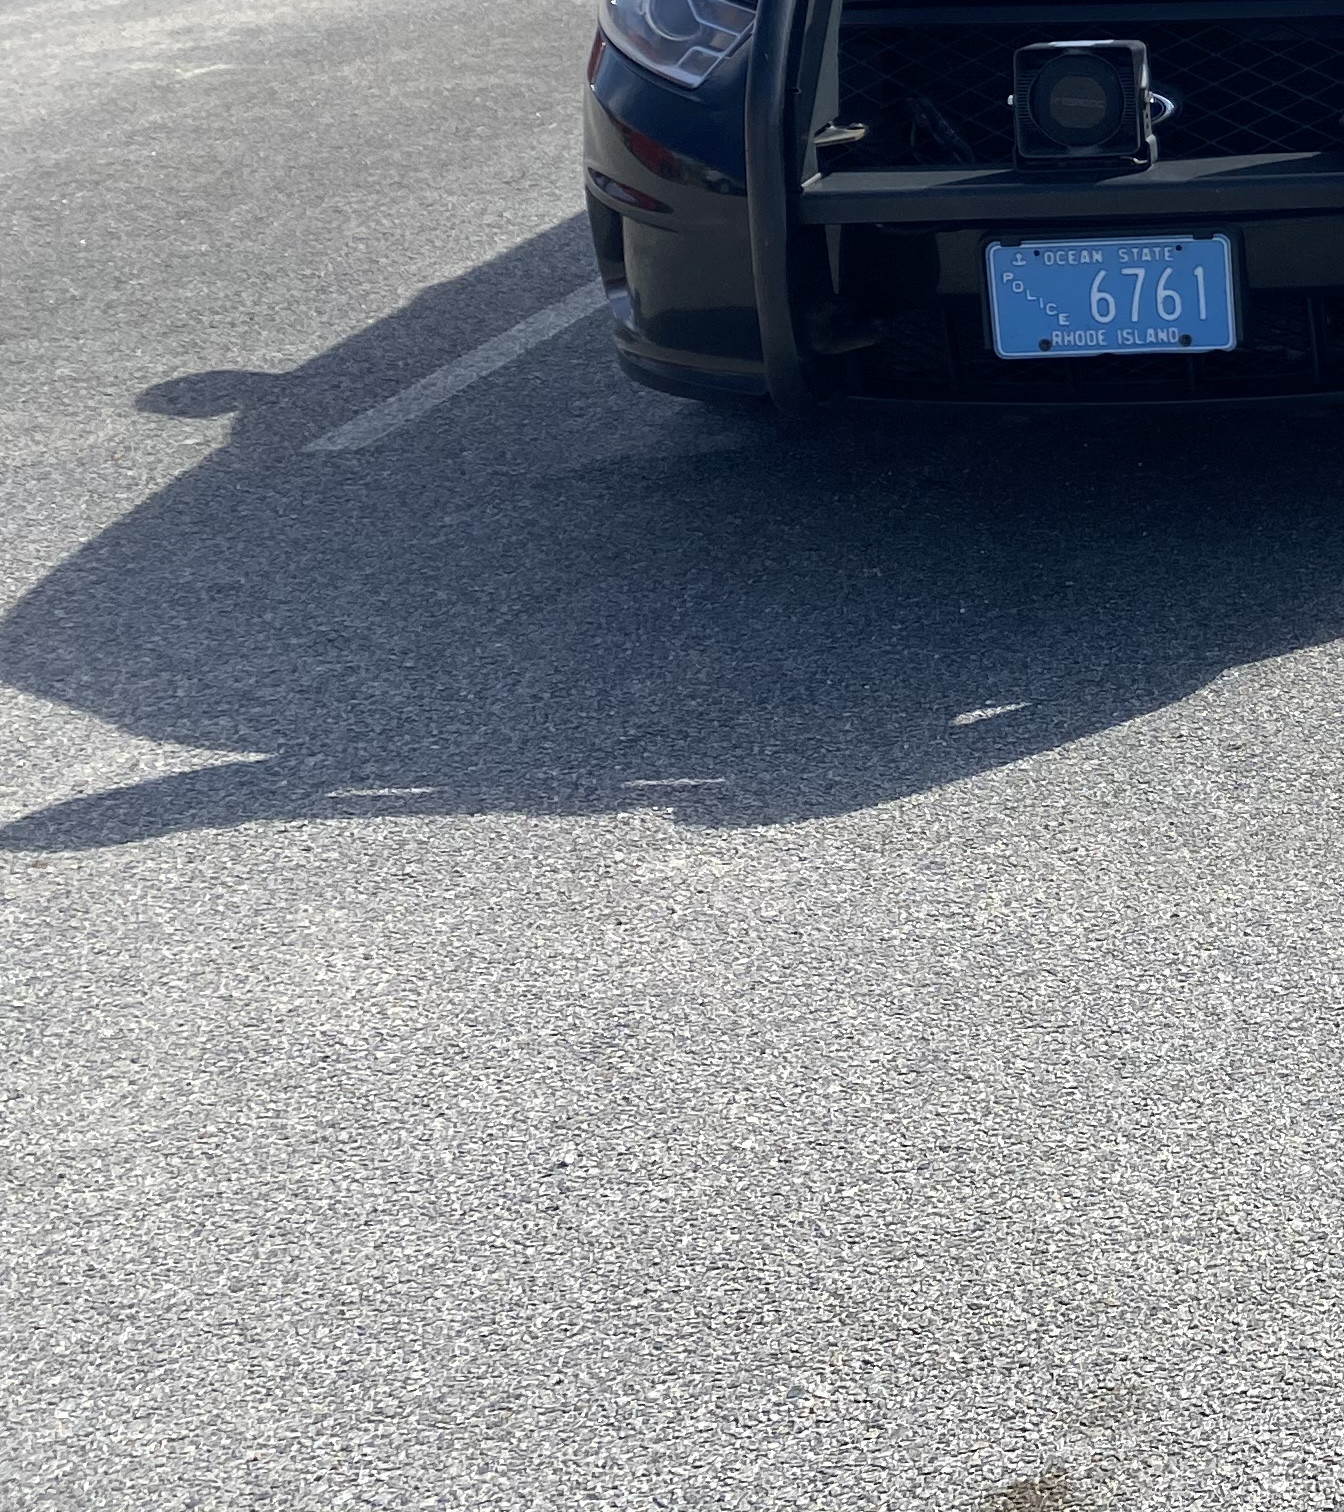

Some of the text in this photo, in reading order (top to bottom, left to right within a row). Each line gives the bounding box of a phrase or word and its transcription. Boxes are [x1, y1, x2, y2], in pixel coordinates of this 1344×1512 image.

[1043, 246, 1174, 266] OCEAN STATE
[1002, 272, 1070, 326] POLICE
[1089, 265, 1207, 324] 6761
[1052, 327, 1180, 347] RHODE ISLAND
